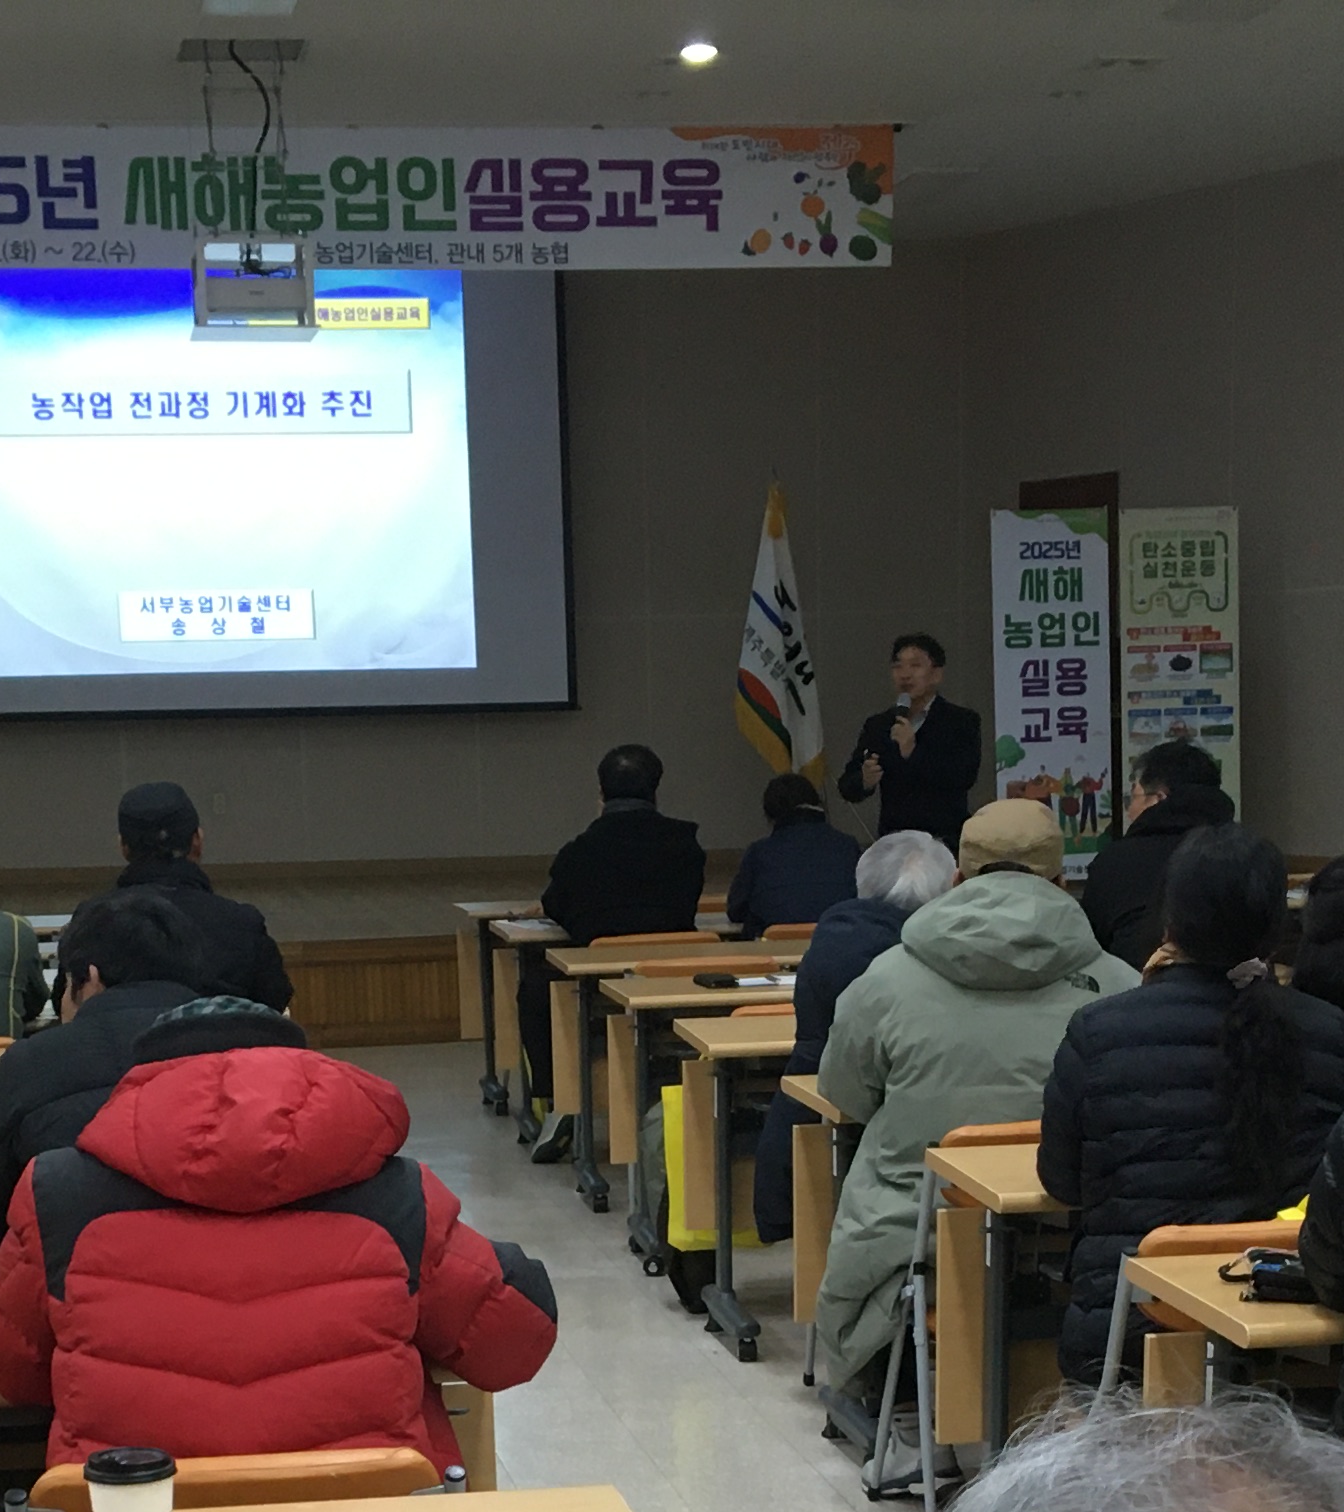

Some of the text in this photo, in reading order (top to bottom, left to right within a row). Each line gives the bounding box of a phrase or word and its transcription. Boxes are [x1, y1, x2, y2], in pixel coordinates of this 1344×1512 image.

[72, 239, 137, 264] 22.(수)
[447, 241, 485, 264] 관내
[493, 242, 523, 264] 5개
[531, 241, 569, 264] 농협
[317, 306, 421, 322] 해농업인실용교육
[31, 390, 373, 420] 농작업 전과정 기계화 추진
[1019, 540, 1081, 560] 2025년
[1142, 540, 1215, 559] 탄소중립
[1142, 559, 1216, 578] 실천운동
[1019, 566, 1083, 603] 새해
[140, 595, 291, 614] 서부농업기술센터
[1002, 611, 1101, 649] 농업인
[1019, 658, 1088, 697] 실용
[1020, 706, 1089, 743] 교육
